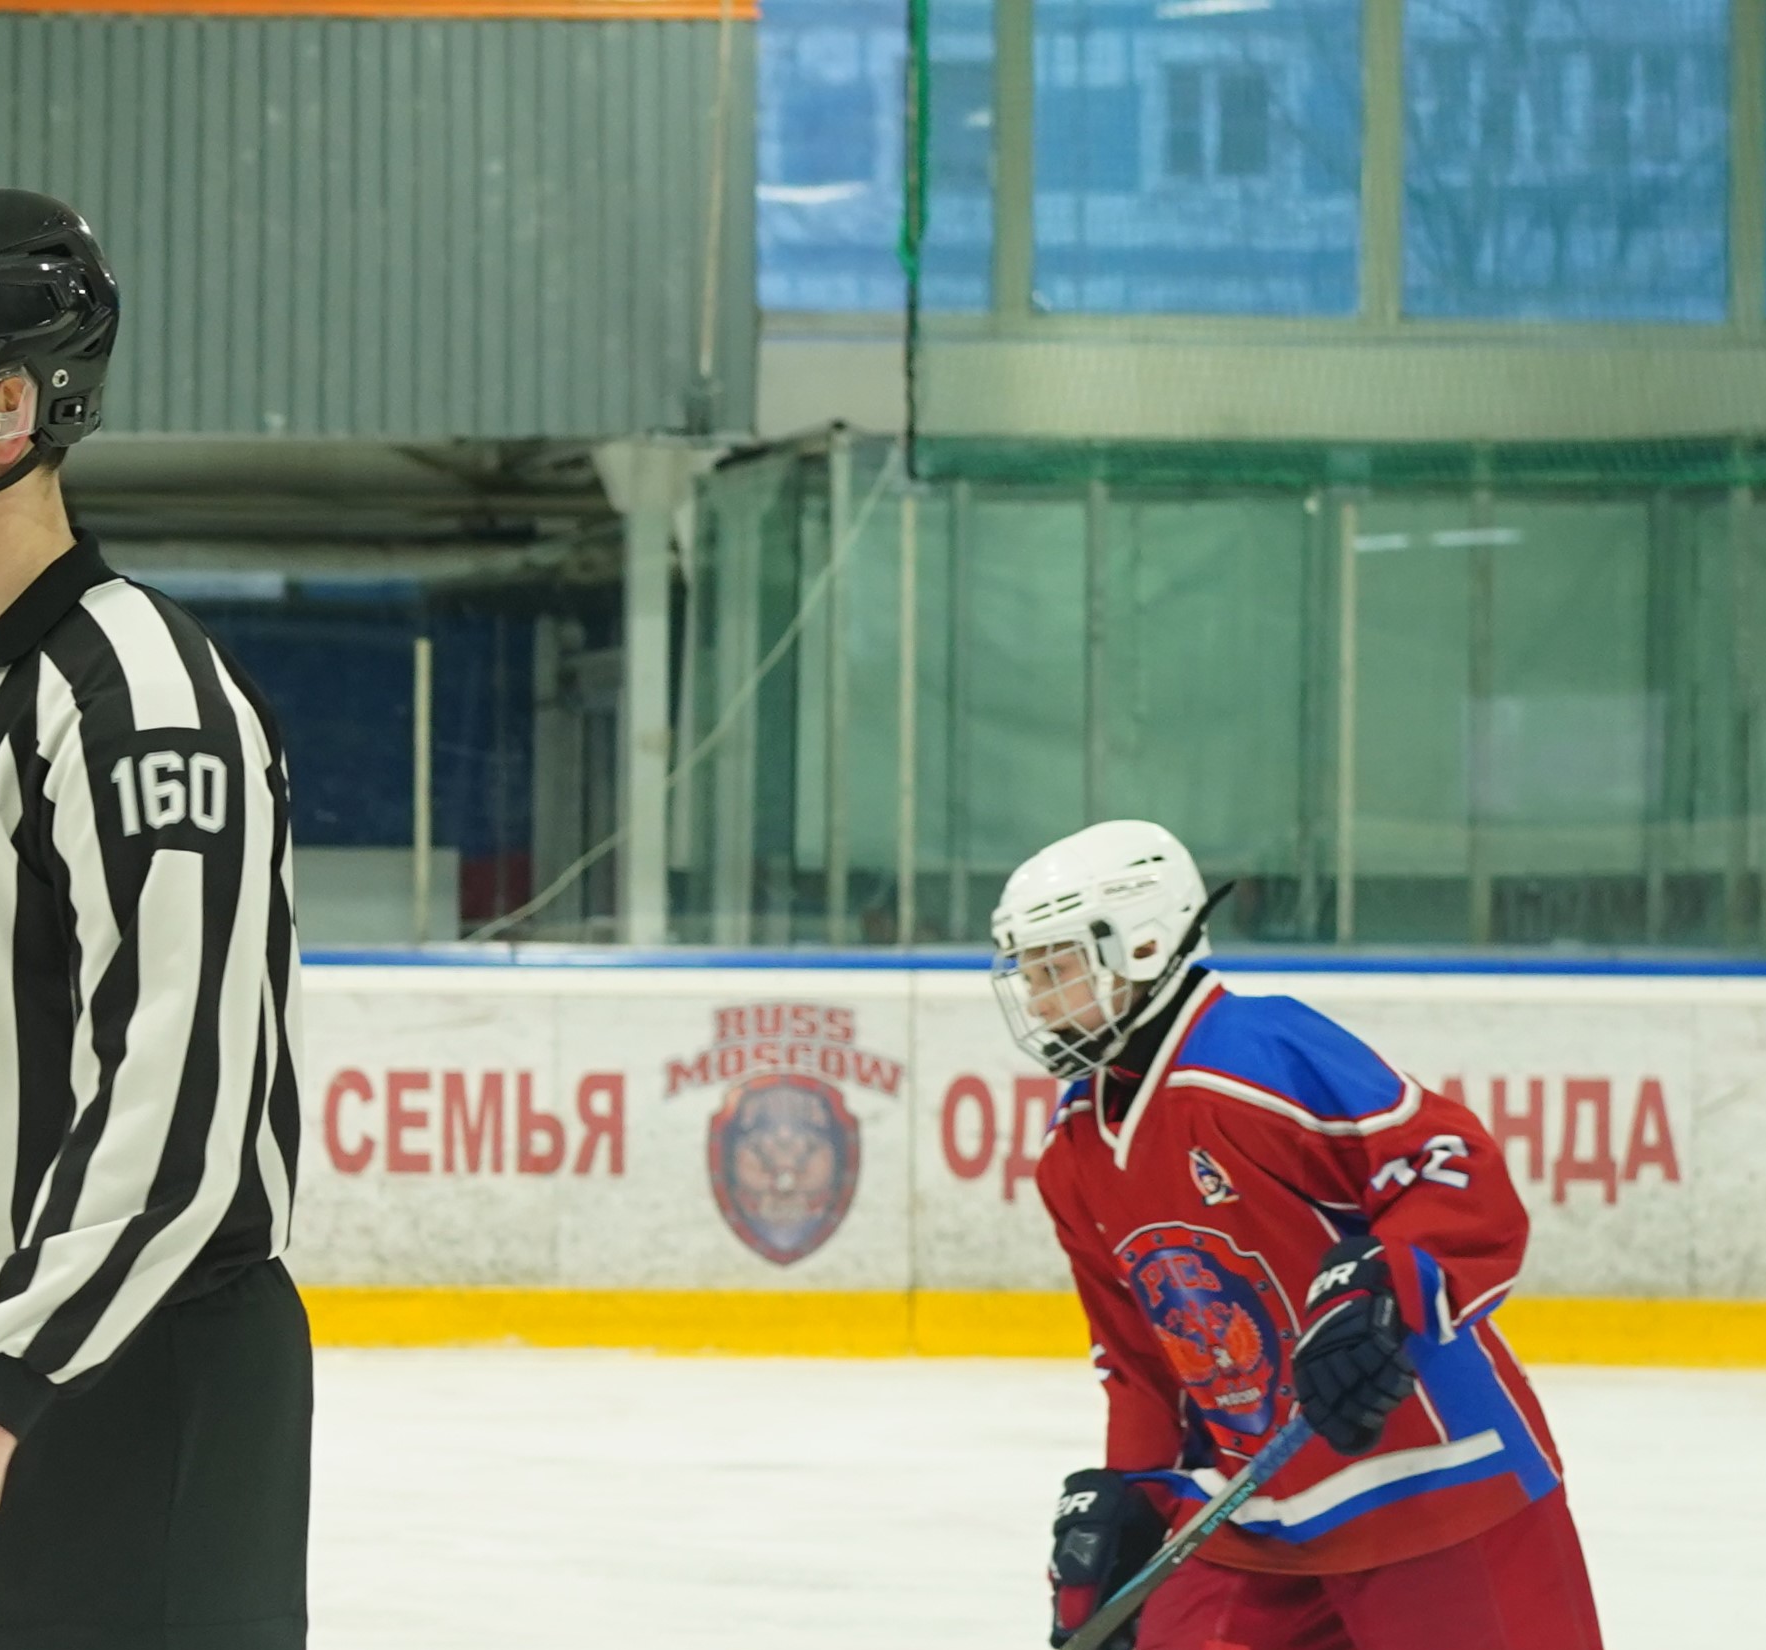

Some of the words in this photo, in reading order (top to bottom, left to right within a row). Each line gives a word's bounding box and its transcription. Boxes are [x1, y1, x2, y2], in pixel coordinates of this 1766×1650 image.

[111, 750, 228, 838] 160
[714, 1005, 855, 1044] RUSS
[665, 1042, 903, 1099] MOSCOW
[323, 1067, 626, 1175] СЕМЬЯ
